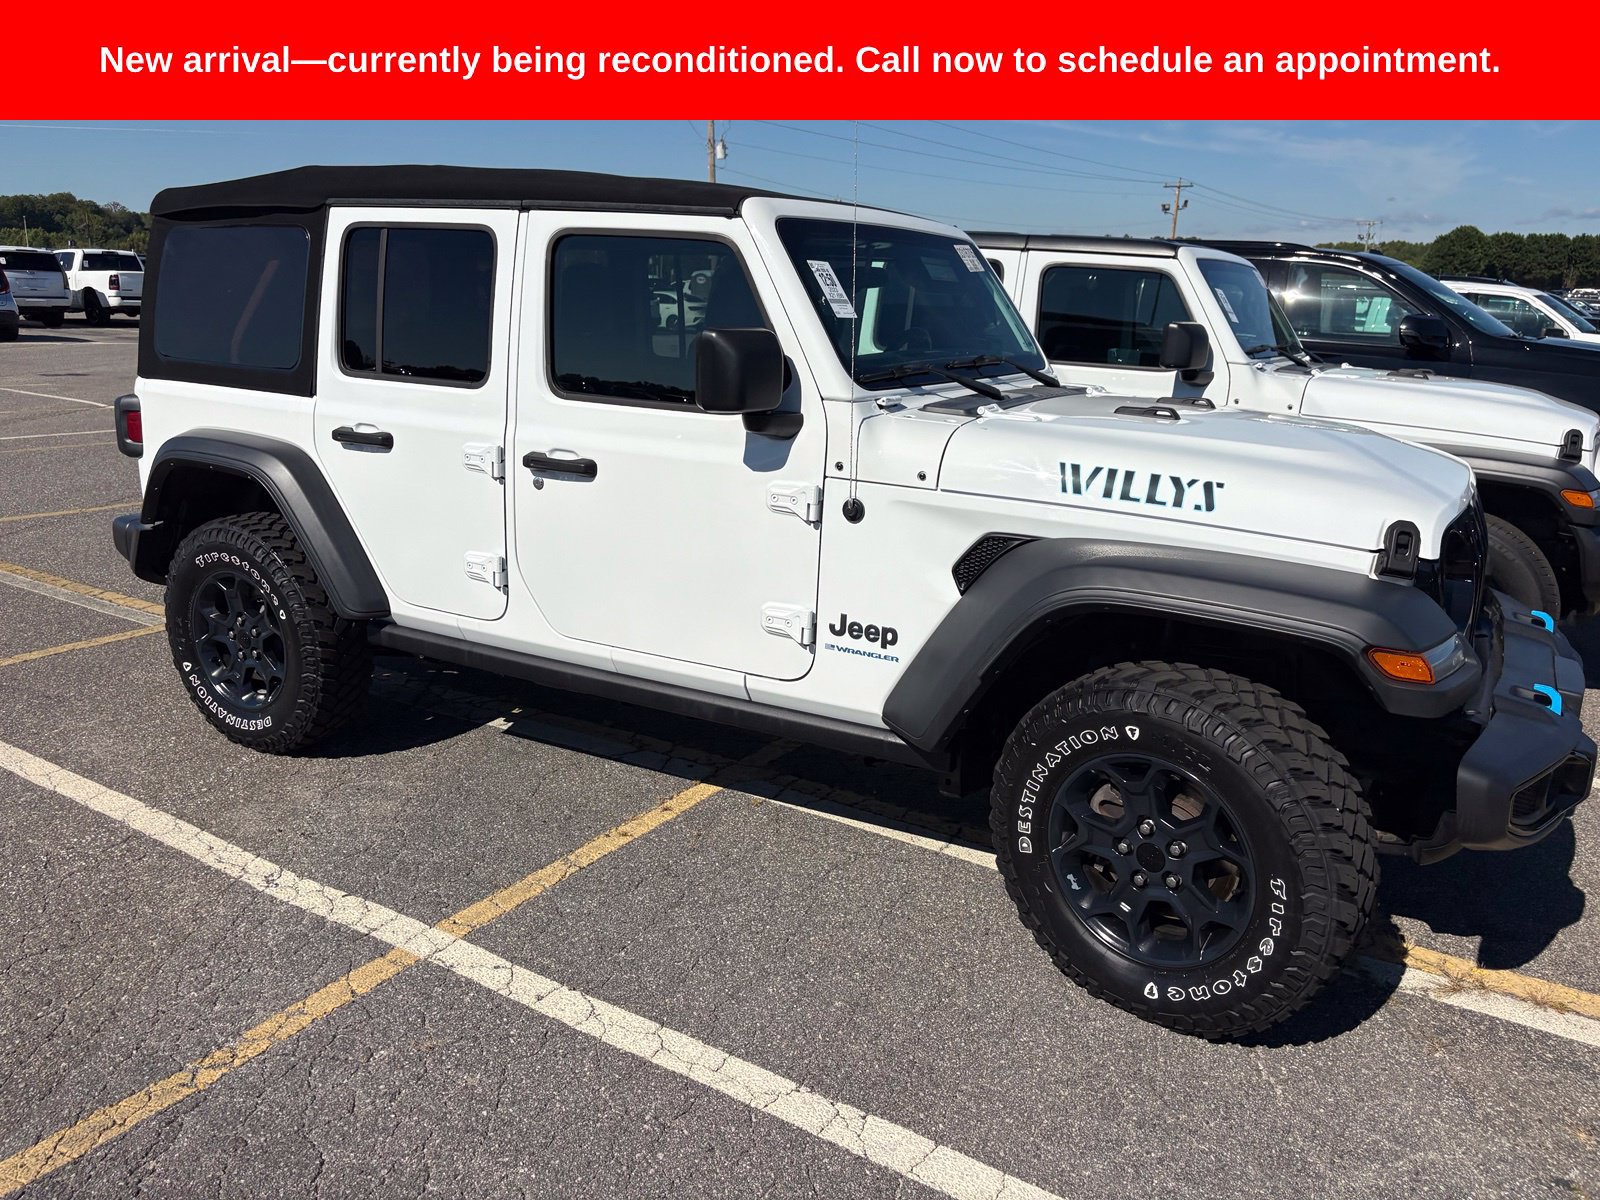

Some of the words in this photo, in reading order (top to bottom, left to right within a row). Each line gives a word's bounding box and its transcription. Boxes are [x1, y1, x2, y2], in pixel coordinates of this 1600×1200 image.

[1059, 462, 1225, 512] WILLYS
[196, 552, 279, 606] Firestone
[828, 613, 899, 650] Jeep
[836, 645, 900, 664] WRANGLER
[189, 674, 272, 730] DESTINATION
[1017, 726, 1119, 854] DESTINATION
[1167, 878, 1287, 1001] Firestone
